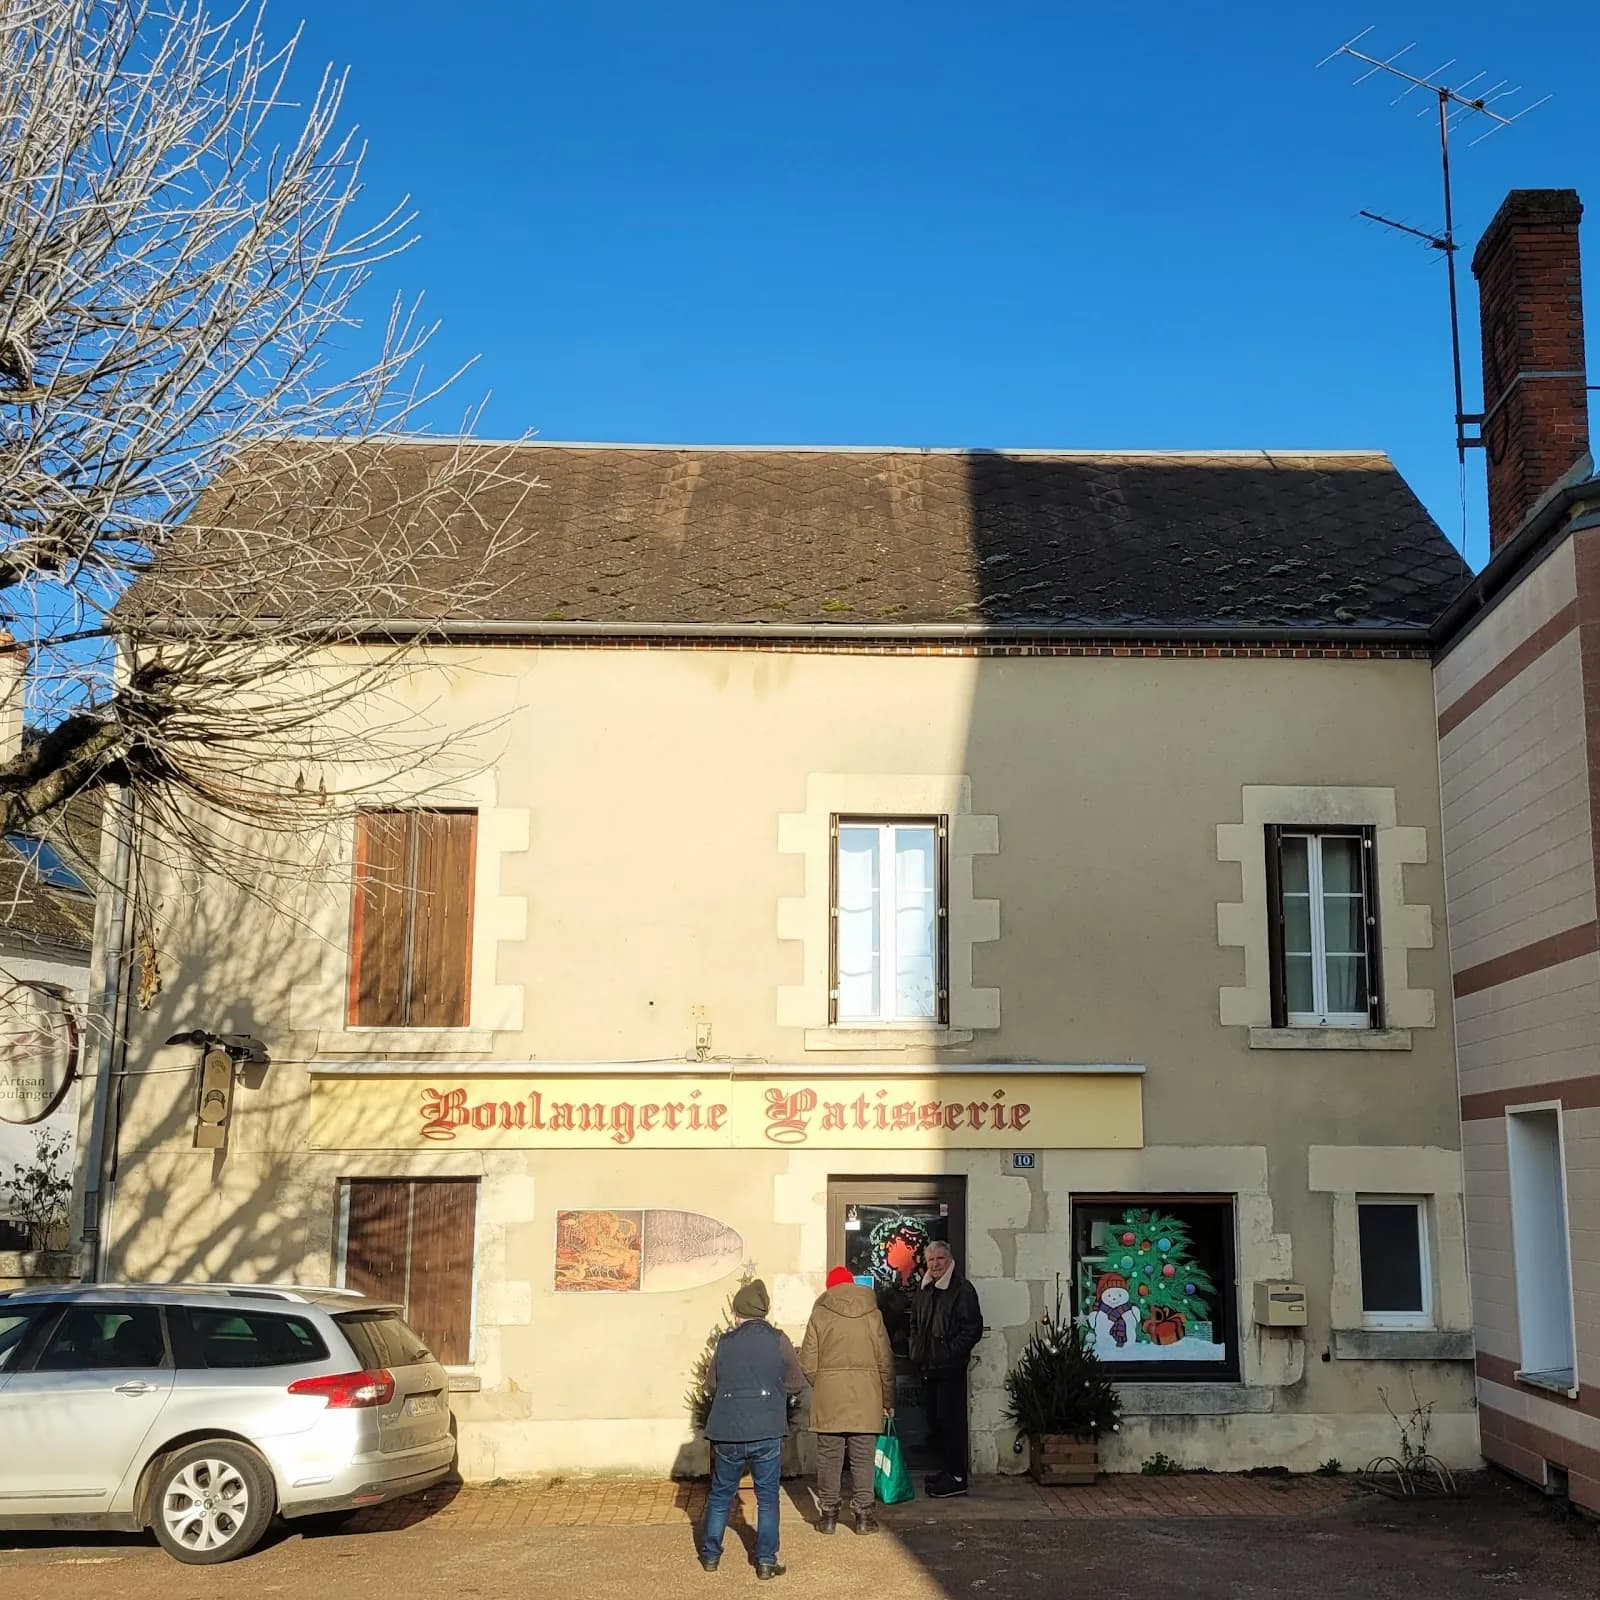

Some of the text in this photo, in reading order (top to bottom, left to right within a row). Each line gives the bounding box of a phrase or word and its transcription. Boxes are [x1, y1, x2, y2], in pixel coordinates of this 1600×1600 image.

[0, 1075, 45, 1086] Artisan
[0, 1088, 54, 1101] oulanger
[420, 1087, 1032, 1144] Boulangerie Patisserie
[1018, 1155, 1030, 1166] 10
